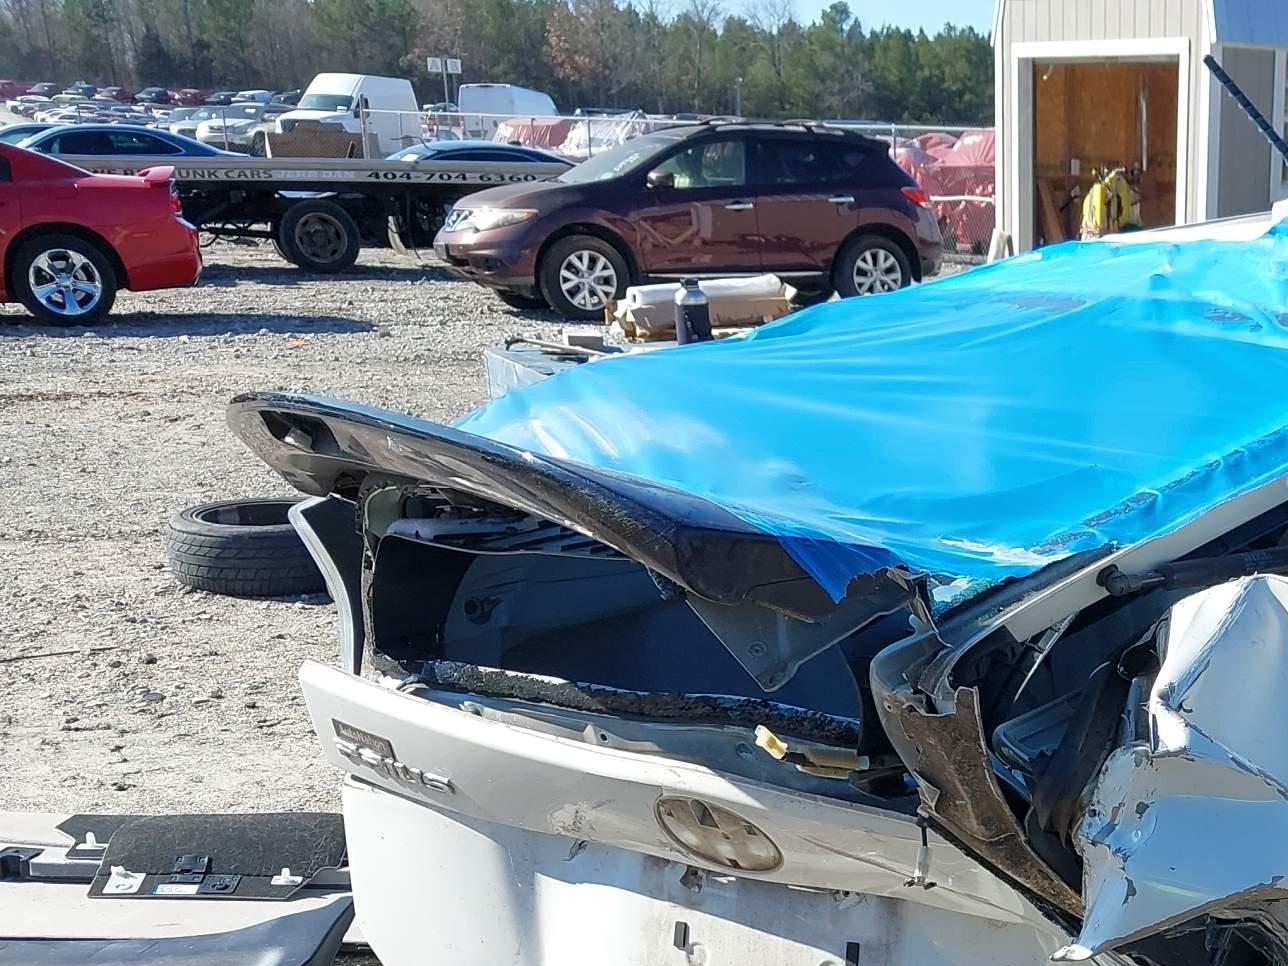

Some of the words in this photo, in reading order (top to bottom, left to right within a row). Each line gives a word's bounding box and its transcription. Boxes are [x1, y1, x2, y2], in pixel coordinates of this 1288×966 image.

[429, 59, 440, 70] A
[177, 169, 219, 179] UNK
[223, 169, 273, 179] CARS
[367, 171, 537, 182] 404-704-6360
